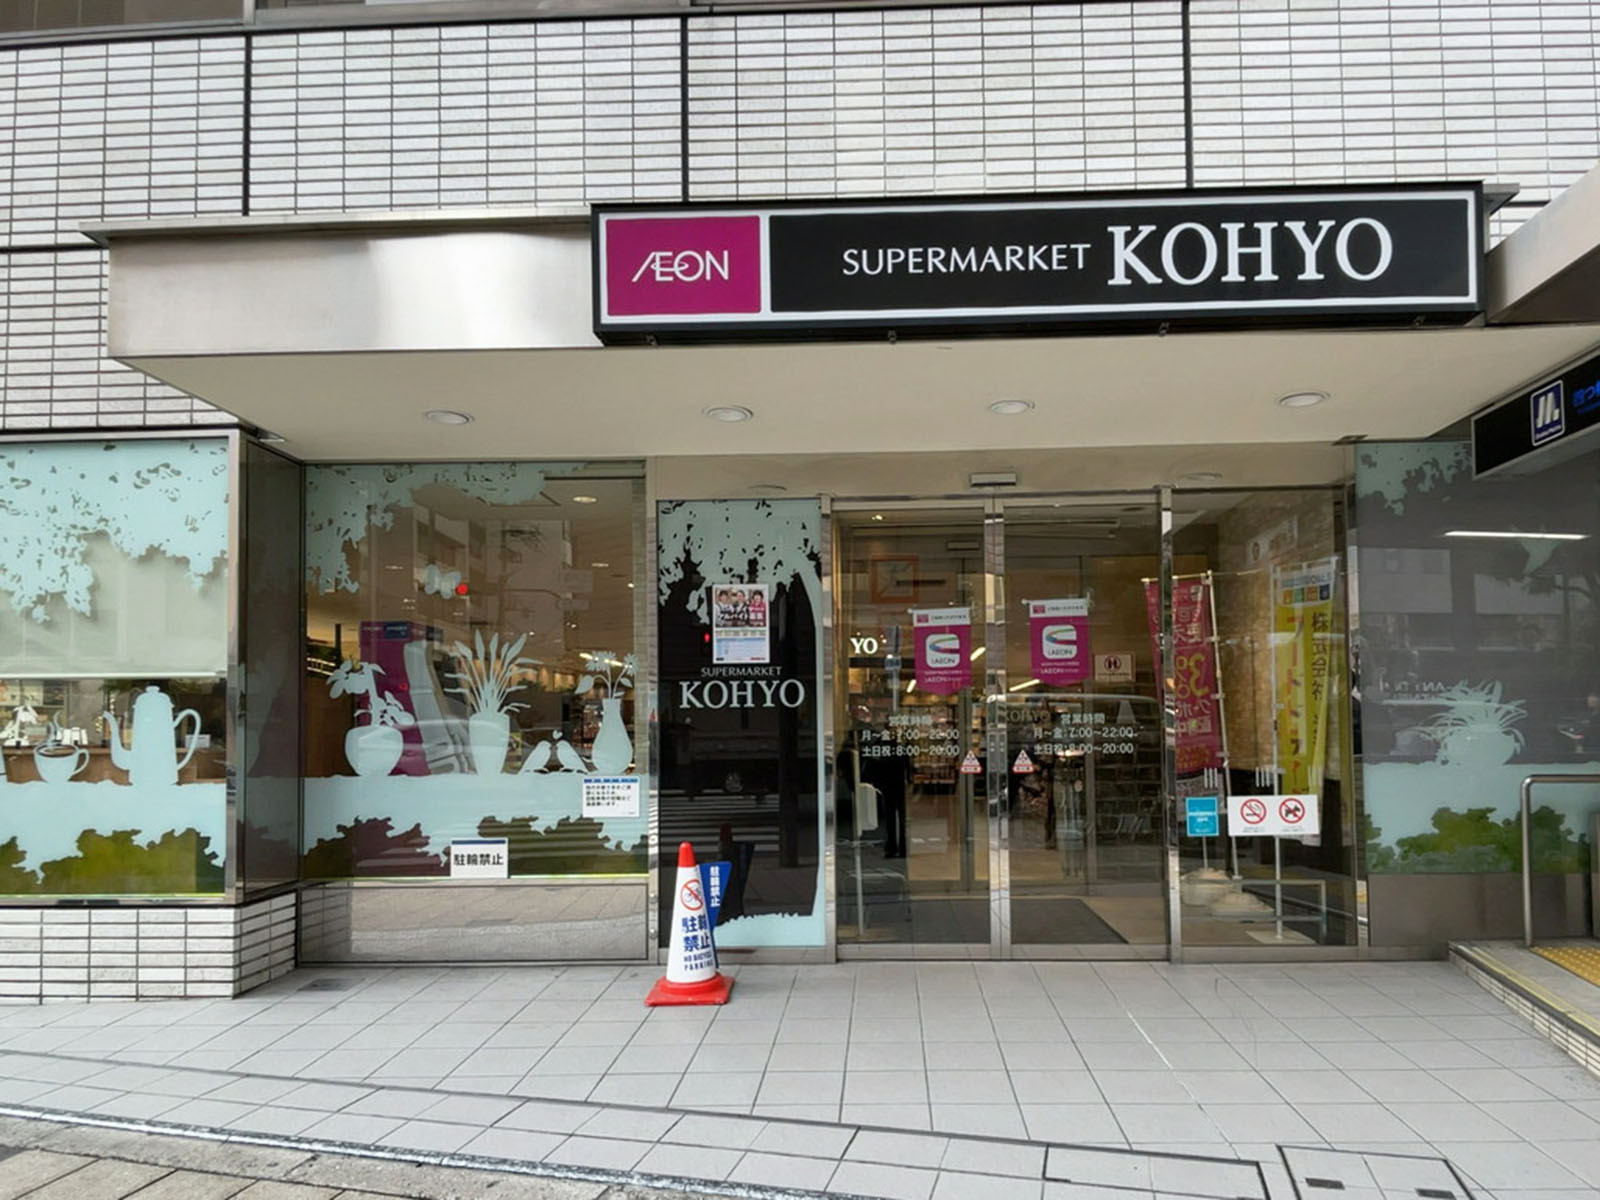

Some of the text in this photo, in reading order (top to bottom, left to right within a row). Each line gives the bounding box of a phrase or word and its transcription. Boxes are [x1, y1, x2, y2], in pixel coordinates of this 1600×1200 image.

[842, 217, 1394, 287] SUPERMARKET KOHYO
[701, 666, 782, 678] SUPERMARKET
[679, 679, 805, 709] KOHYO
